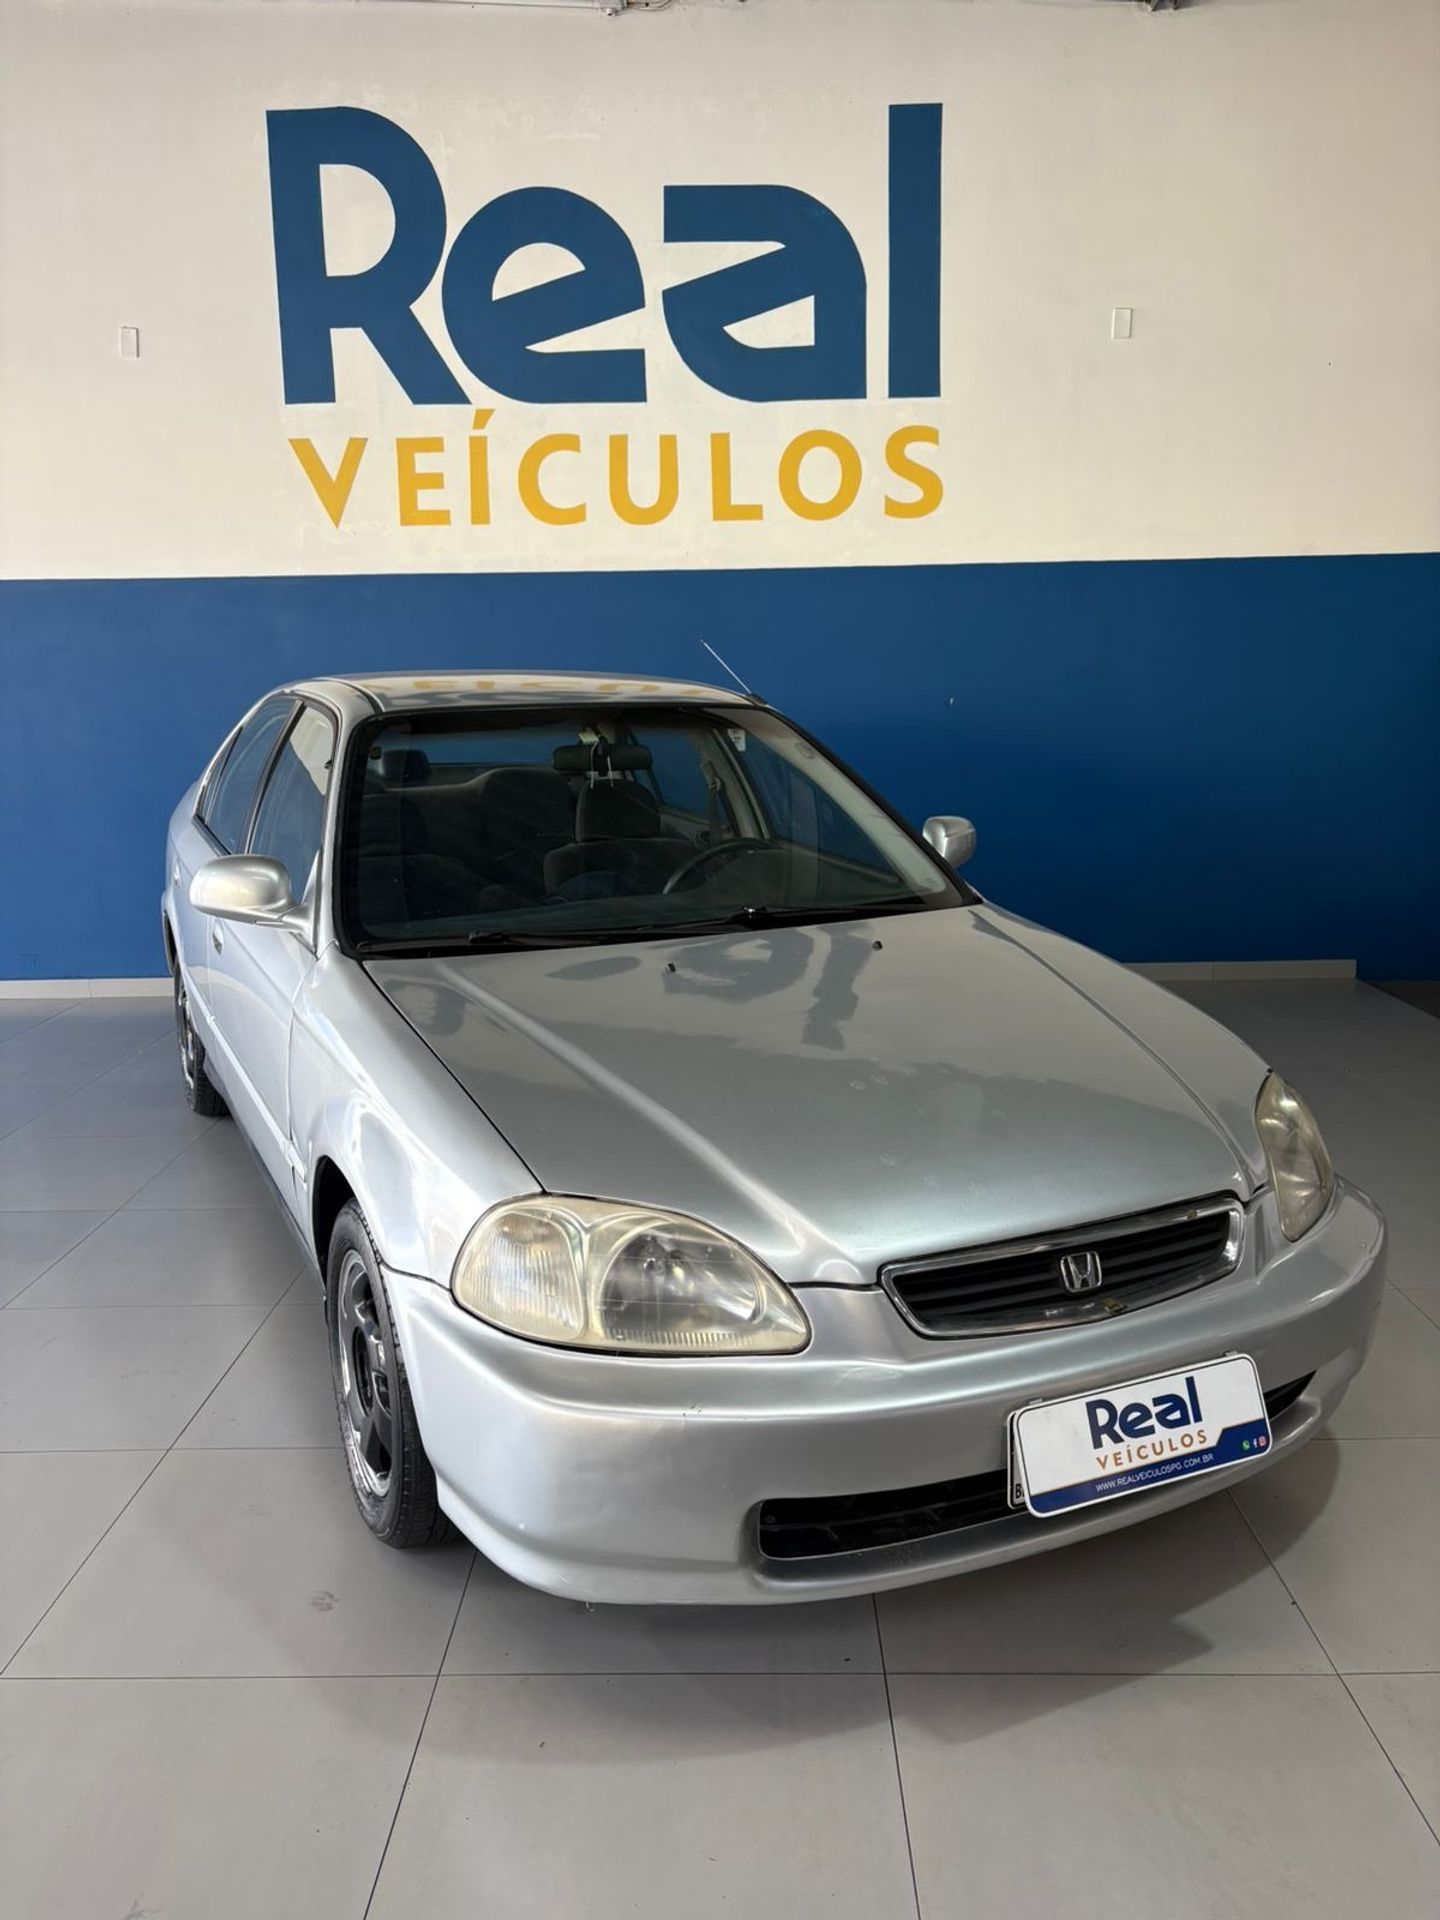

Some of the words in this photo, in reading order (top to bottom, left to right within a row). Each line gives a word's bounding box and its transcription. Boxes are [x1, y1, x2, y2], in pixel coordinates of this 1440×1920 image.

[265, 103, 944, 404] Real
[289, 408, 944, 528] VEÍCULOS
[1085, 1375, 1203, 1450] Real
[1096, 1429, 1208, 1471] VEÍCULOS
[1095, 1453, 1214, 1493] WWW.REALVEICULOSPG.COM.BR
